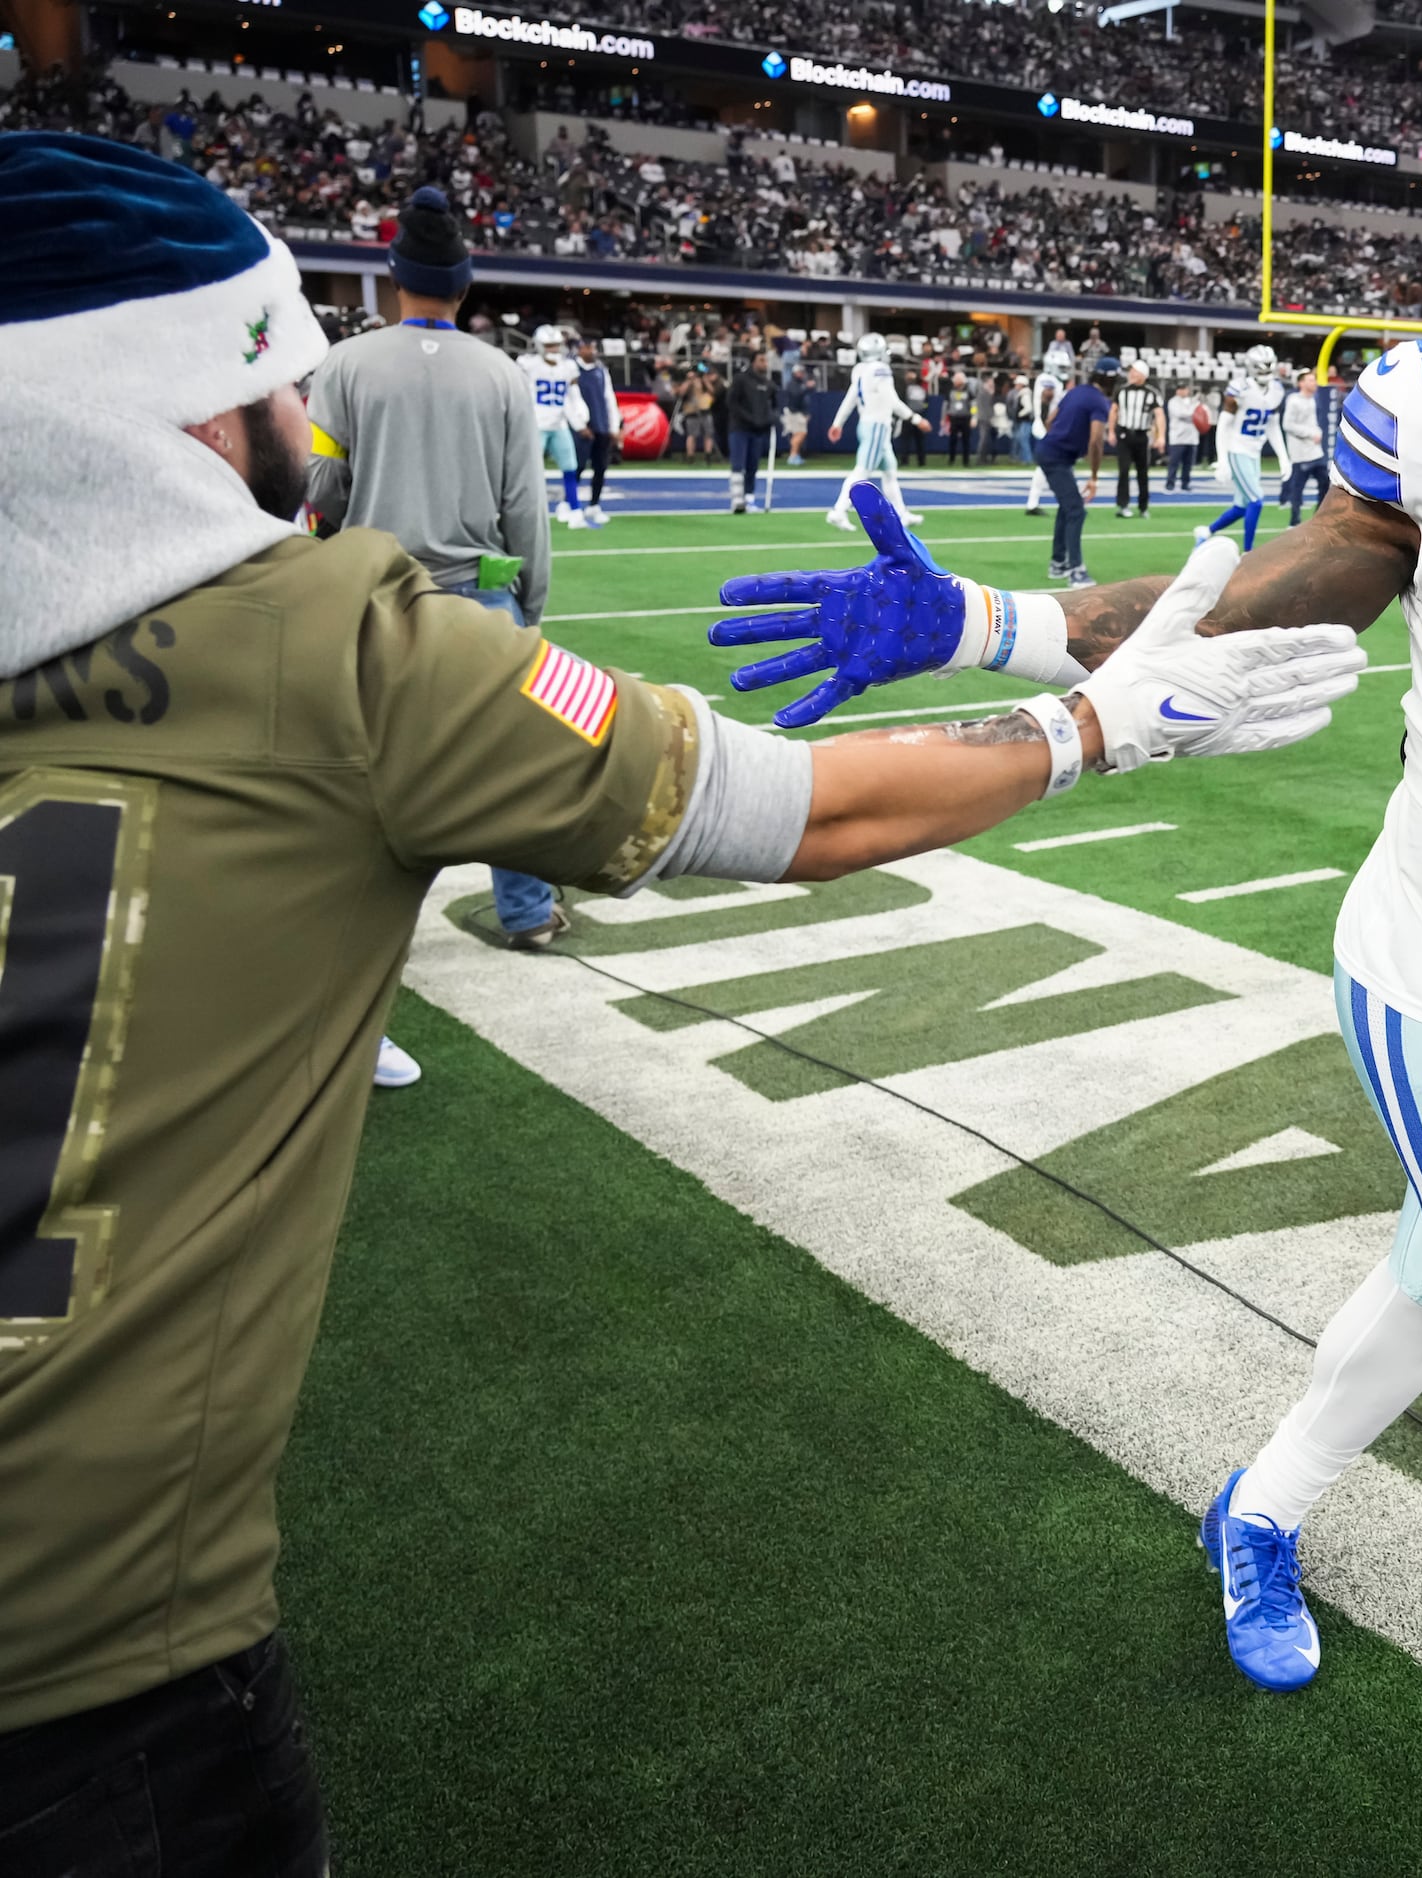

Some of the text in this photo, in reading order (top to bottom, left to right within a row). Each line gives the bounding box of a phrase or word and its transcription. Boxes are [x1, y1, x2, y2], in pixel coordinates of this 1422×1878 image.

[455, 7, 654, 60] Blockchain.com
[790, 57, 951, 101] Blockchain.com
[1061, 98, 1194, 136] Blockchain.com
[536, 380, 568, 406] 29
[994, 614, 1003, 635] WAY
